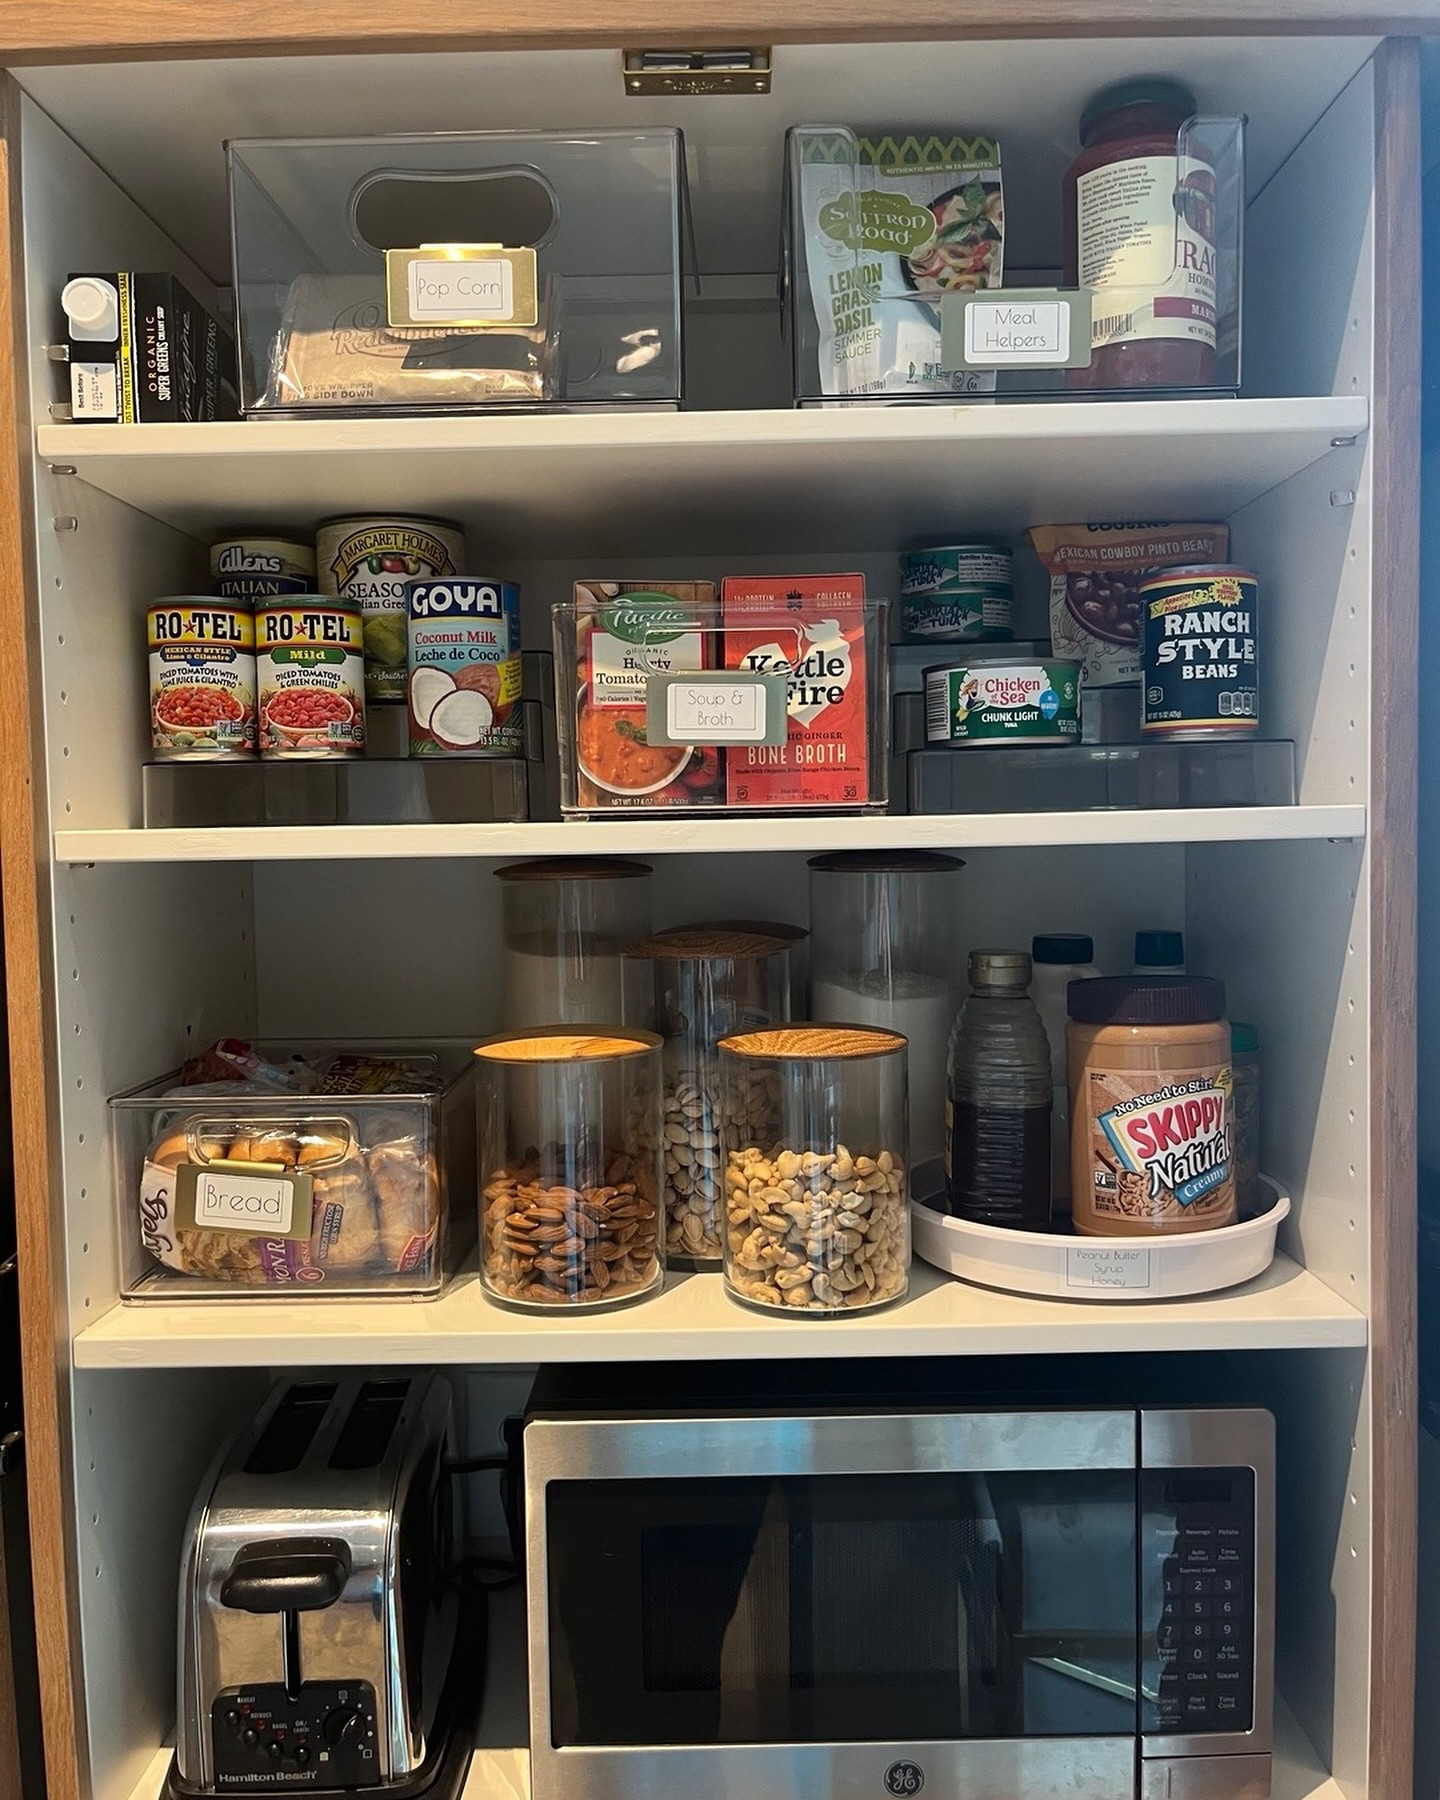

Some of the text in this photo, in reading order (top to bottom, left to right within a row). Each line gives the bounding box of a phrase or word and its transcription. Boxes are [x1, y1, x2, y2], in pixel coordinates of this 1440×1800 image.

[418, 277, 501, 299] Pop Corn
[833, 307, 876, 338] BASIL
[995, 308, 1037, 325] Meal
[833, 328, 882, 351] SIMMER
[985, 331, 1046, 350] Helpers
[145, 316, 157, 392] ORGANIC
[156, 341, 170, 373] GREENS
[834, 343, 872, 364] SAUCE
[158, 374, 171, 401] SUPER
[340, 389, 374, 399] DOWN
[123, 409, 132, 424] UST
[344, 533, 398, 561] MARGARET
[401, 534, 445, 561] HOLMES
[1100, 546, 1145, 560] COWBOY
[1149, 541, 1180, 557] PINTO
[221, 580, 280, 595] ITALIAN
[347, 582, 405, 599] SEASO
[361, 598, 380, 609] lian
[412, 585, 498, 615] GOYA
[1164, 610, 1250, 637] RANCH
[415, 631, 497, 645] Coconut Milk
[289, 650, 326, 660] Mild
[415, 648, 500, 662] Leche de Coco
[1155, 637, 1255, 666] STYLE
[160, 667, 239, 681] DICED TOMATOES WITH
[275, 669, 341, 682] DICED TOMATOES
[1182, 663, 1239, 680] BEANS
[201, 676, 237, 689] CILANTRO
[286, 678, 310, 688] GREEN
[311, 678, 339, 689] CHILIES
[984, 677, 1041, 694] Chicken
[687, 690, 743, 706] Soup &
[999, 691, 1026, 706] Sea
[697, 712, 734, 726] Broth
[981, 711, 1039, 723] CHUNK LIGHT
[804, 732, 843, 740] GINGER
[748, 743, 846, 765] BONE BROTH
[1113, 1102, 1134, 1116] No
[1134, 1085, 1172, 1109] Need
[1172, 1084, 1187, 1097] to
[1126, 1095, 1224, 1160] SKIPPY
[1145, 1123, 1232, 1197] Natural
[1183, 1167, 1226, 1199] Creamy
[206, 1184, 281, 1215] Bread
[1077, 1249, 1141, 1260] Peanut Butter
[1094, 1262, 1124, 1274] Syrup
[301, 1272, 319, 1280] 6
[1091, 1275, 1126, 1286] Honey
[1165, 1581, 1172, 1591] 1
[1194, 1580, 1202, 1591] 2
[1224, 1579, 1232, 1590] 3
[1165, 1603, 1172, 1613] 4
[1194, 1602, 1202, 1613] 5
[1223, 1602, 1231, 1612] 6
[1165, 1625, 1172, 1635] 7
[1194, 1625, 1202, 1635] 8
[1223, 1624, 1231, 1634] 9
[1193, 1648, 1202, 1659] 0
[1187, 1672, 1208, 1680] Clock
[1216, 1671, 1239, 1679] Sound
[218, 1770, 317, 1783] Hamilton Beach
